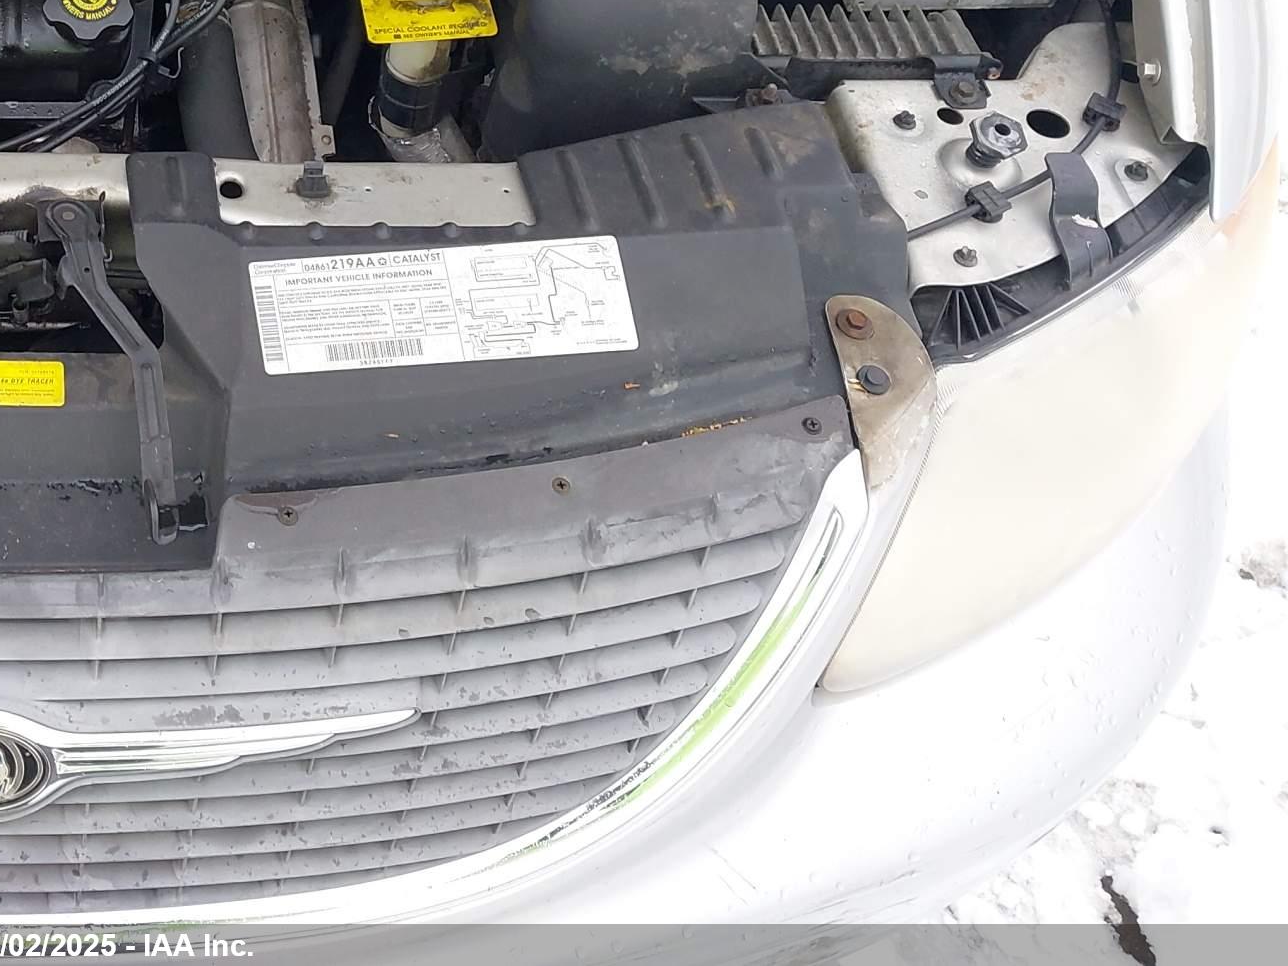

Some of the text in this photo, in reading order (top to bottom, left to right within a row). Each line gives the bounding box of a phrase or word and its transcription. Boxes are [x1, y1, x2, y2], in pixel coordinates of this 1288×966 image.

[85, 6, 115, 20] MANUAL
[407, 24, 447, 33] COOLANT
[393, 252, 442, 264] CATALYST
[285, 269, 433, 286] IMPORTANT VEHICLE INFORMATION
